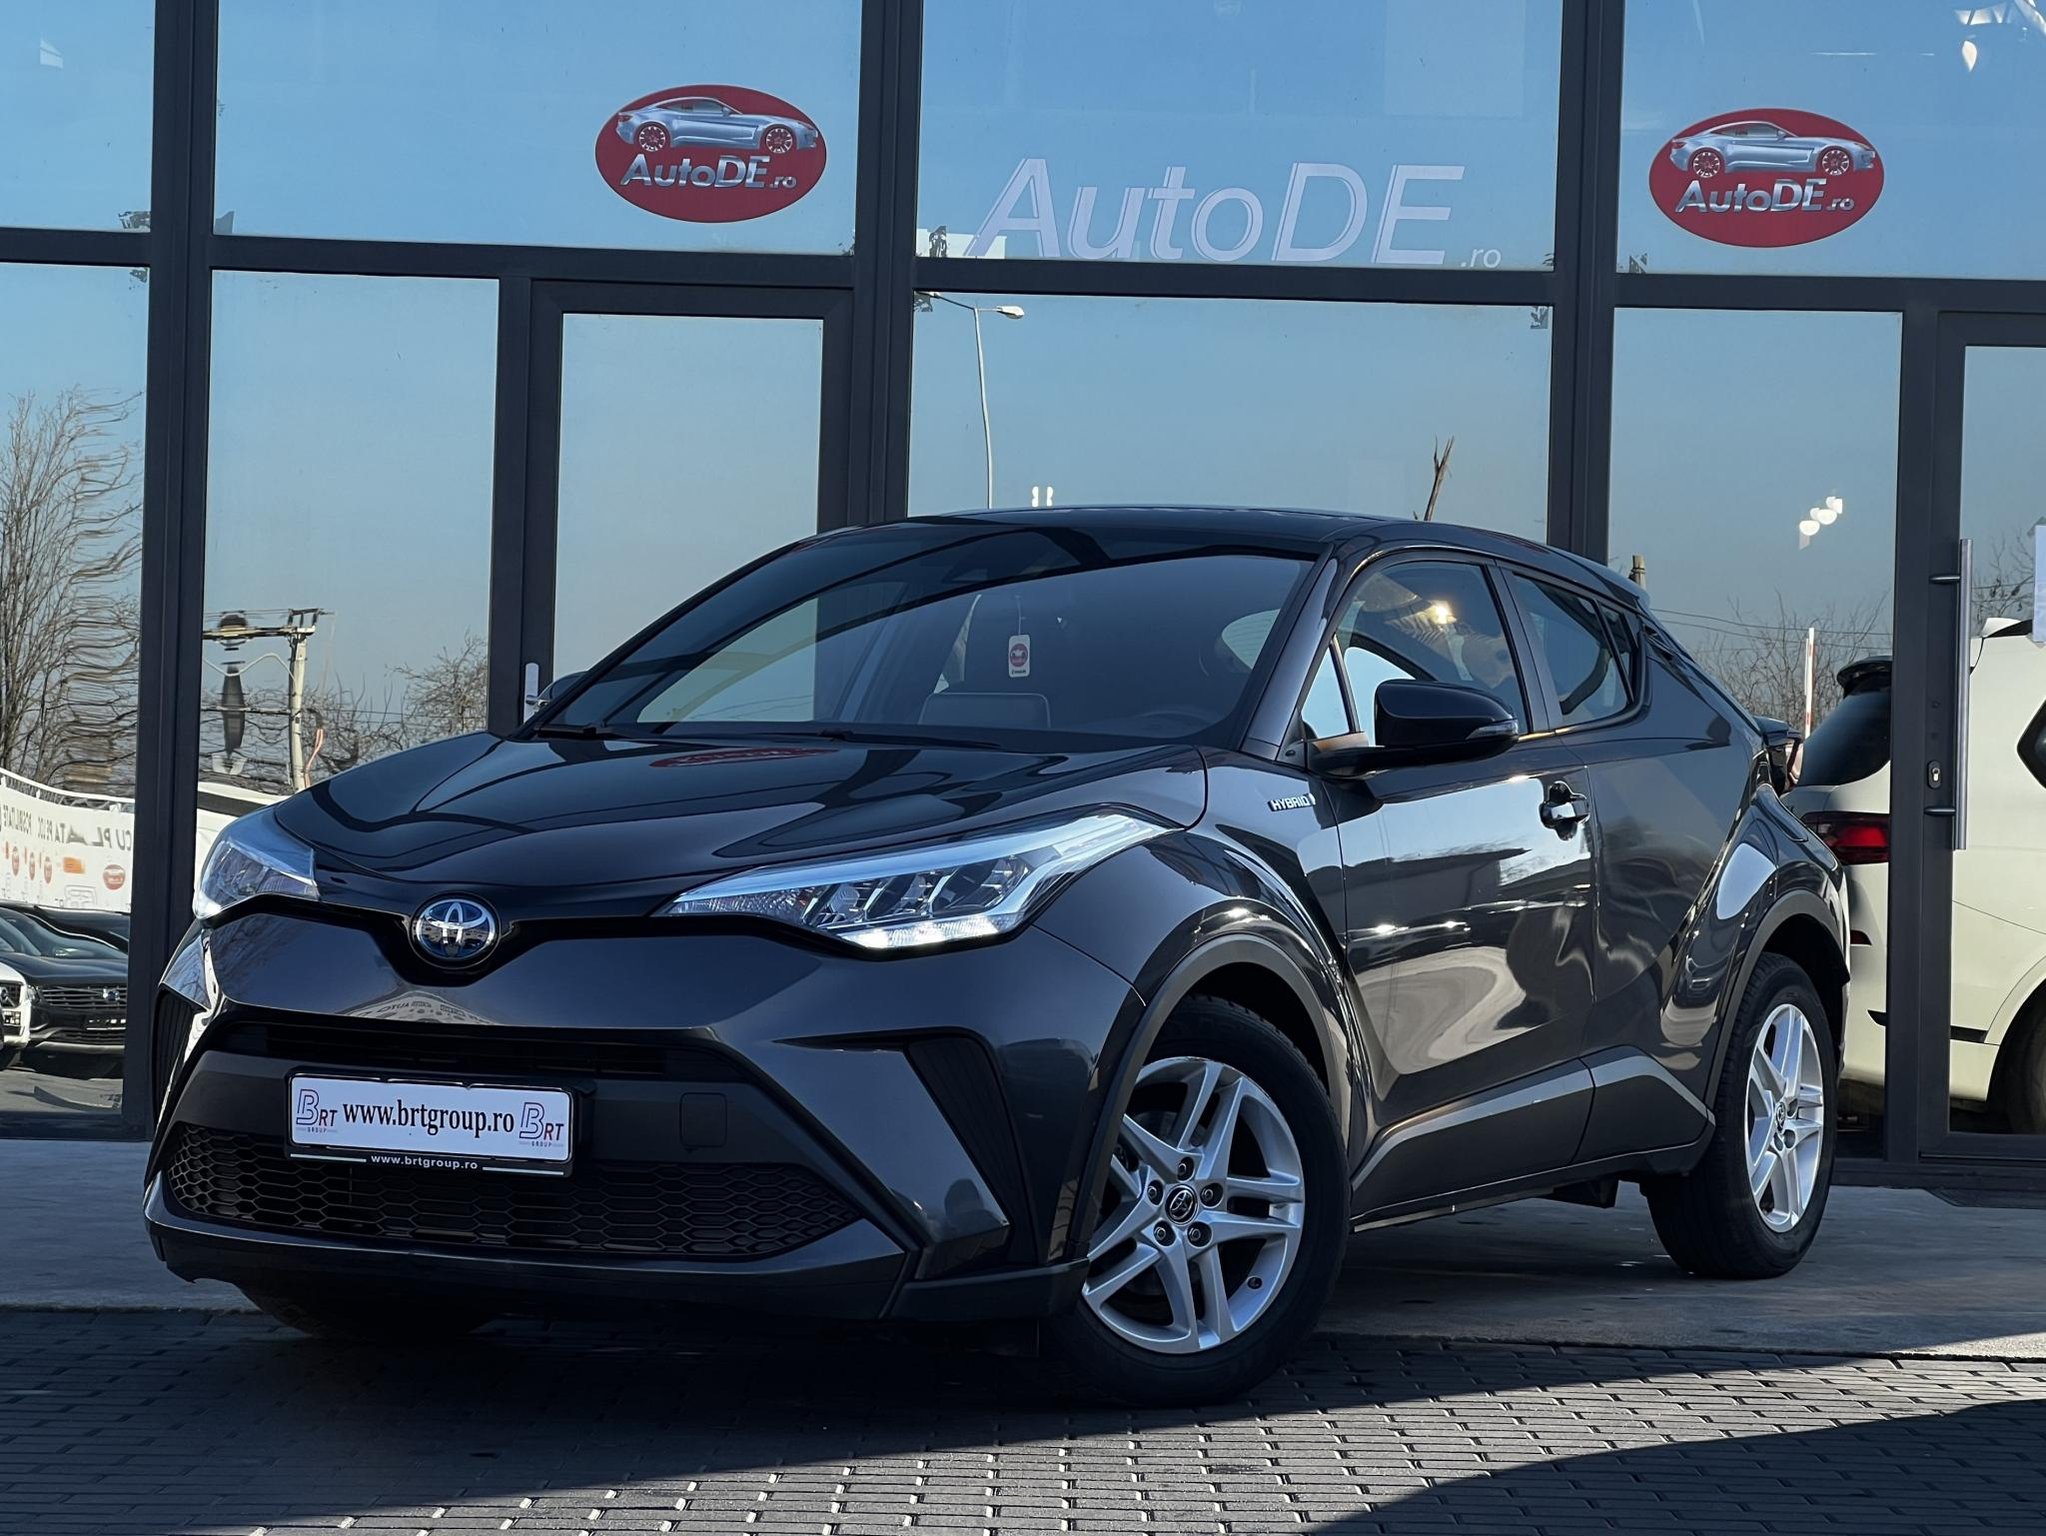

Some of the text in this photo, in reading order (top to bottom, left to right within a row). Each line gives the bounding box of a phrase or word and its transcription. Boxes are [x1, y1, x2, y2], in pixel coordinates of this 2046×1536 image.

[1271, 795, 1311, 811] HYBRID
[296, 1088, 564, 1140] BRT www.brtgroup.ro BRT
[371, 1154, 478, 1171] www.brtgroup.ro
